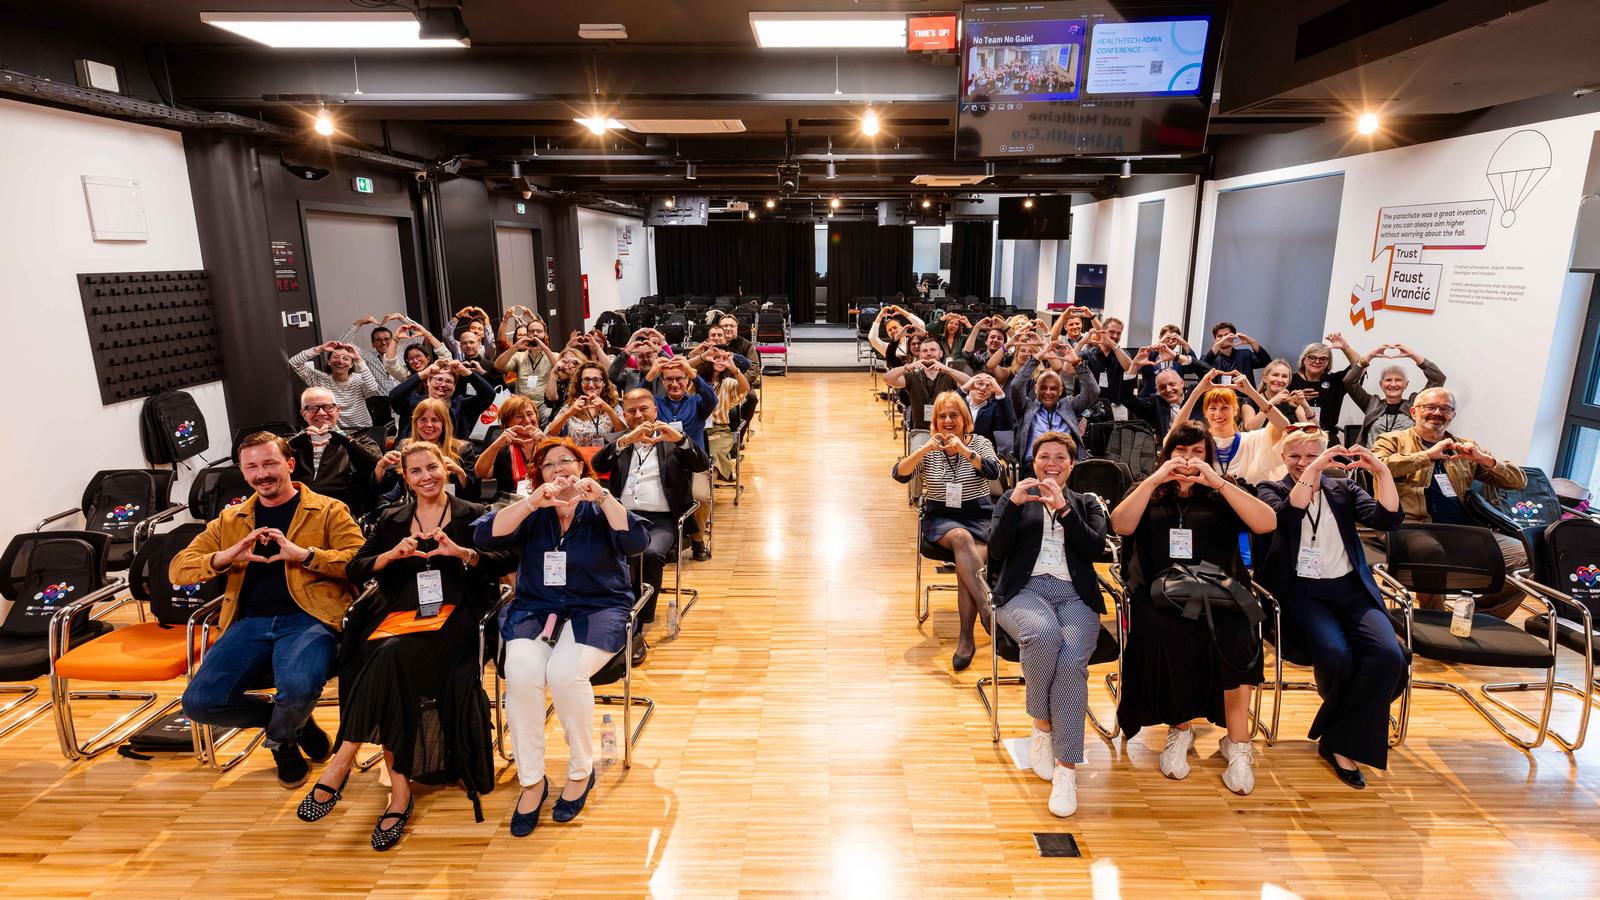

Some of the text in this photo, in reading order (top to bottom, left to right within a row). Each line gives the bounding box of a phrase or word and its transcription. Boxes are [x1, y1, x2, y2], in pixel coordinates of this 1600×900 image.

[914, 28, 950, 37] TIME'S UP!
[1015, 34, 1034, 43] Gain!
[1393, 212, 1420, 220] parachute
[1457, 208, 1487, 216] invention,
[1446, 220, 1465, 228] higher
[1396, 249, 1418, 258] Trust
[1393, 271, 1423, 284] Faust
[1391, 286, 1431, 300] Vrančić
